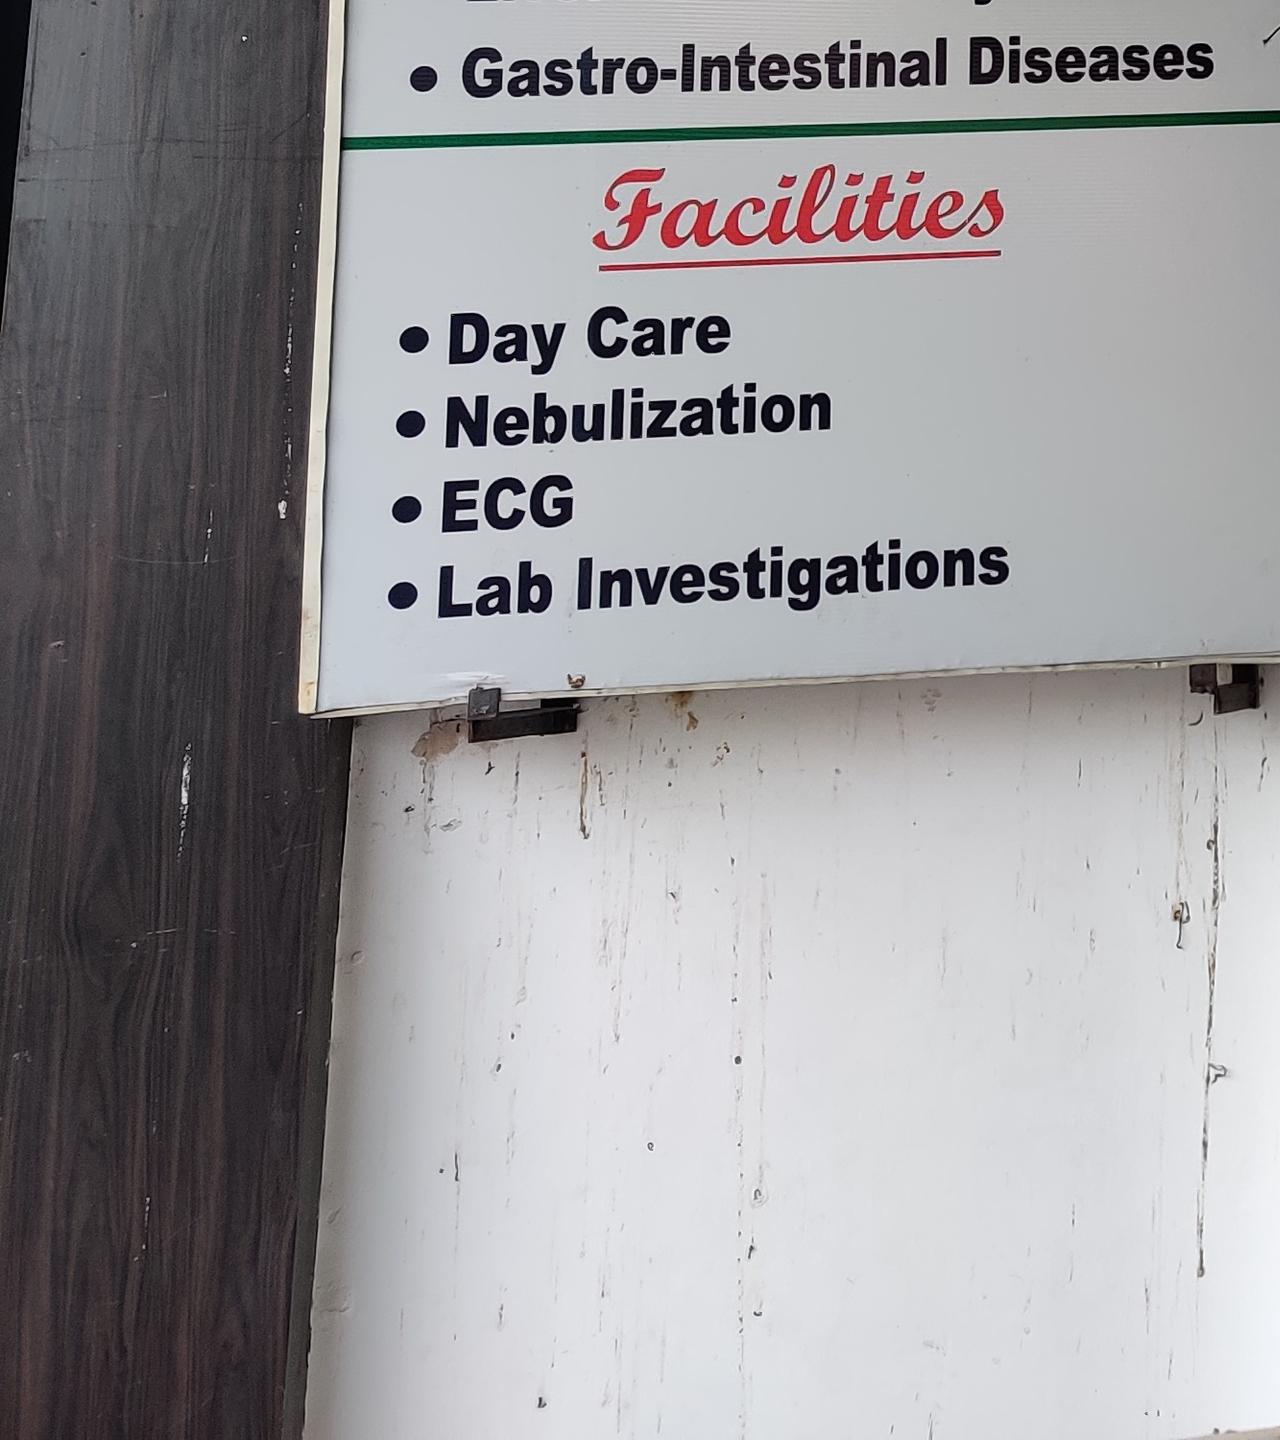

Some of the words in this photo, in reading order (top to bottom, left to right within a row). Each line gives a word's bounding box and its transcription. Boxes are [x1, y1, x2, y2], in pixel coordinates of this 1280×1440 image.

[462, 37, 946, 100] Gastro-Intestinal
[969, 35, 1214, 86] Diseases
[592, 164, 1004, 251] Facilities
[448, 313, 565, 374] Day
[586, 305, 731, 358] Care
[444, 383, 832, 449] Nebulization
[440, 475, 575, 534] ECG
[437, 560, 553, 620] Lab
[577, 538, 1009, 610] Investigations
